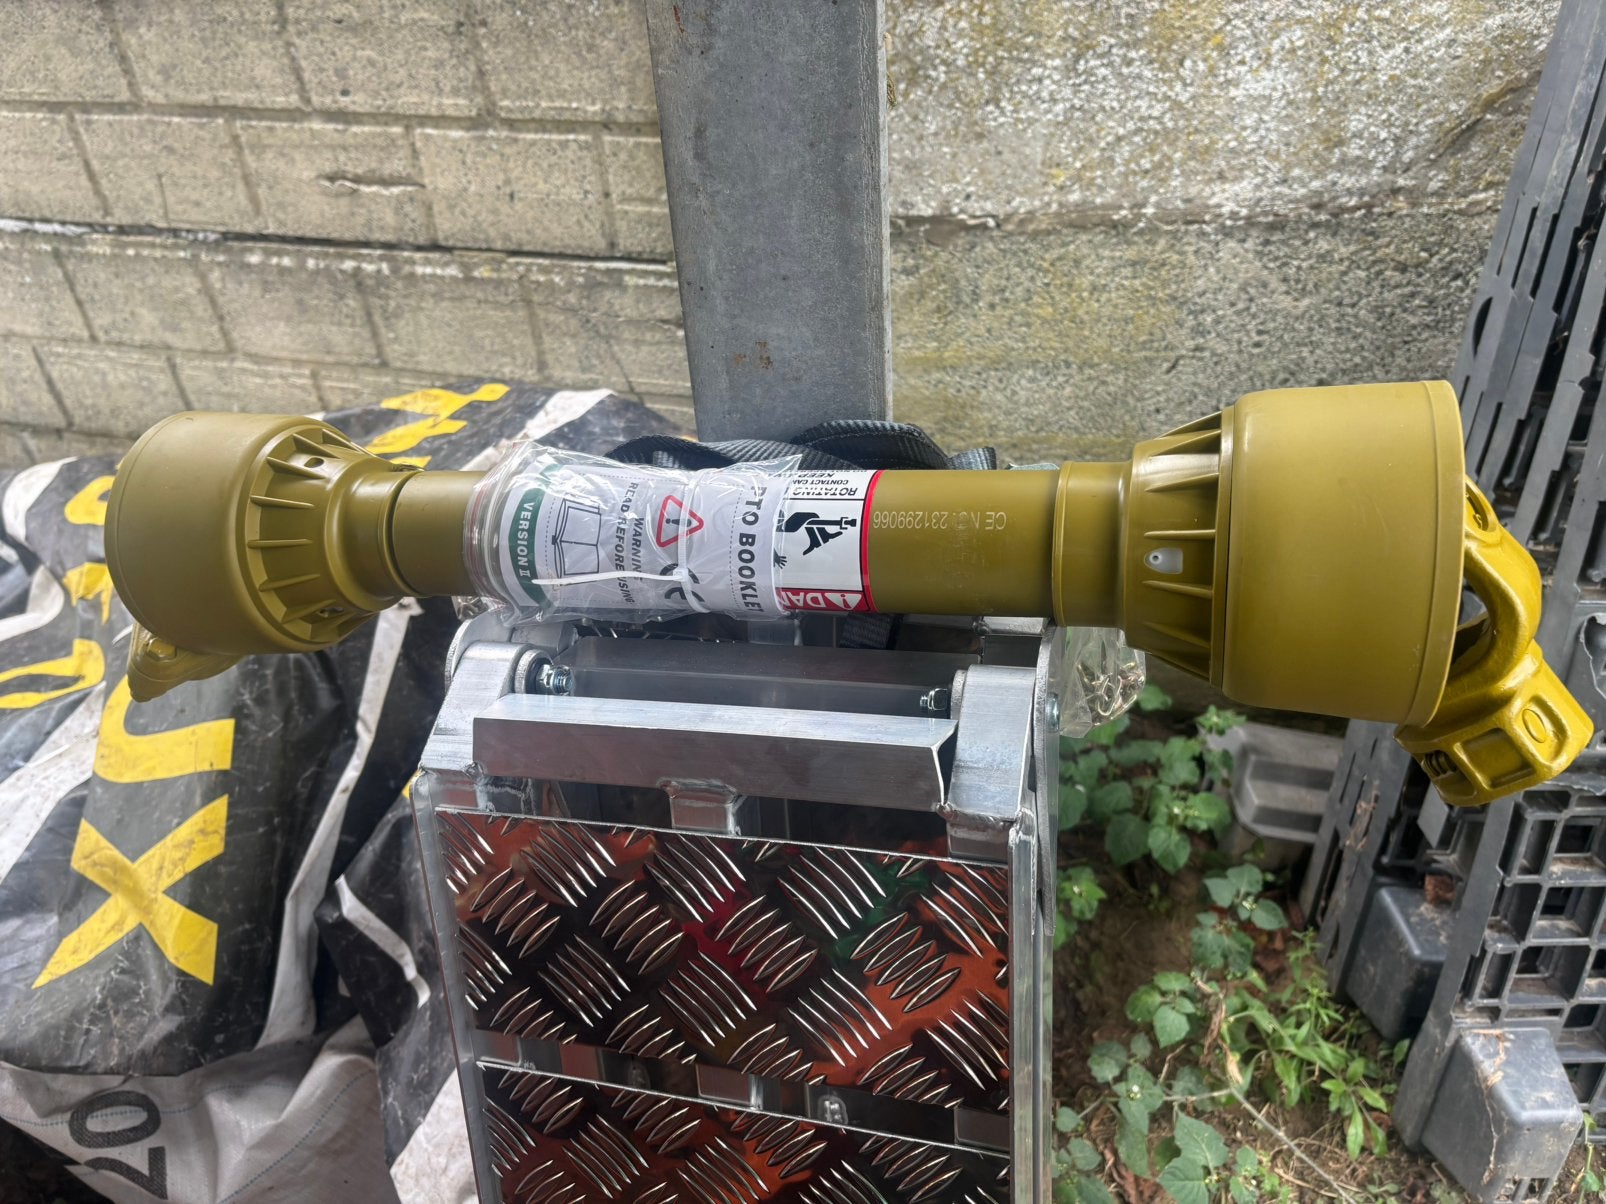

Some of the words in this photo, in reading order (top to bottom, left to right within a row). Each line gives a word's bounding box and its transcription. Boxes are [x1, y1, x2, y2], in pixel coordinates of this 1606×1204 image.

[741, 486, 767, 526] PTO
[873, 511, 948, 529] 231299066
[985, 511, 1007, 530] CE
[517, 502, 535, 567] VERSION
[737, 533, 764, 612] BOOKLET
